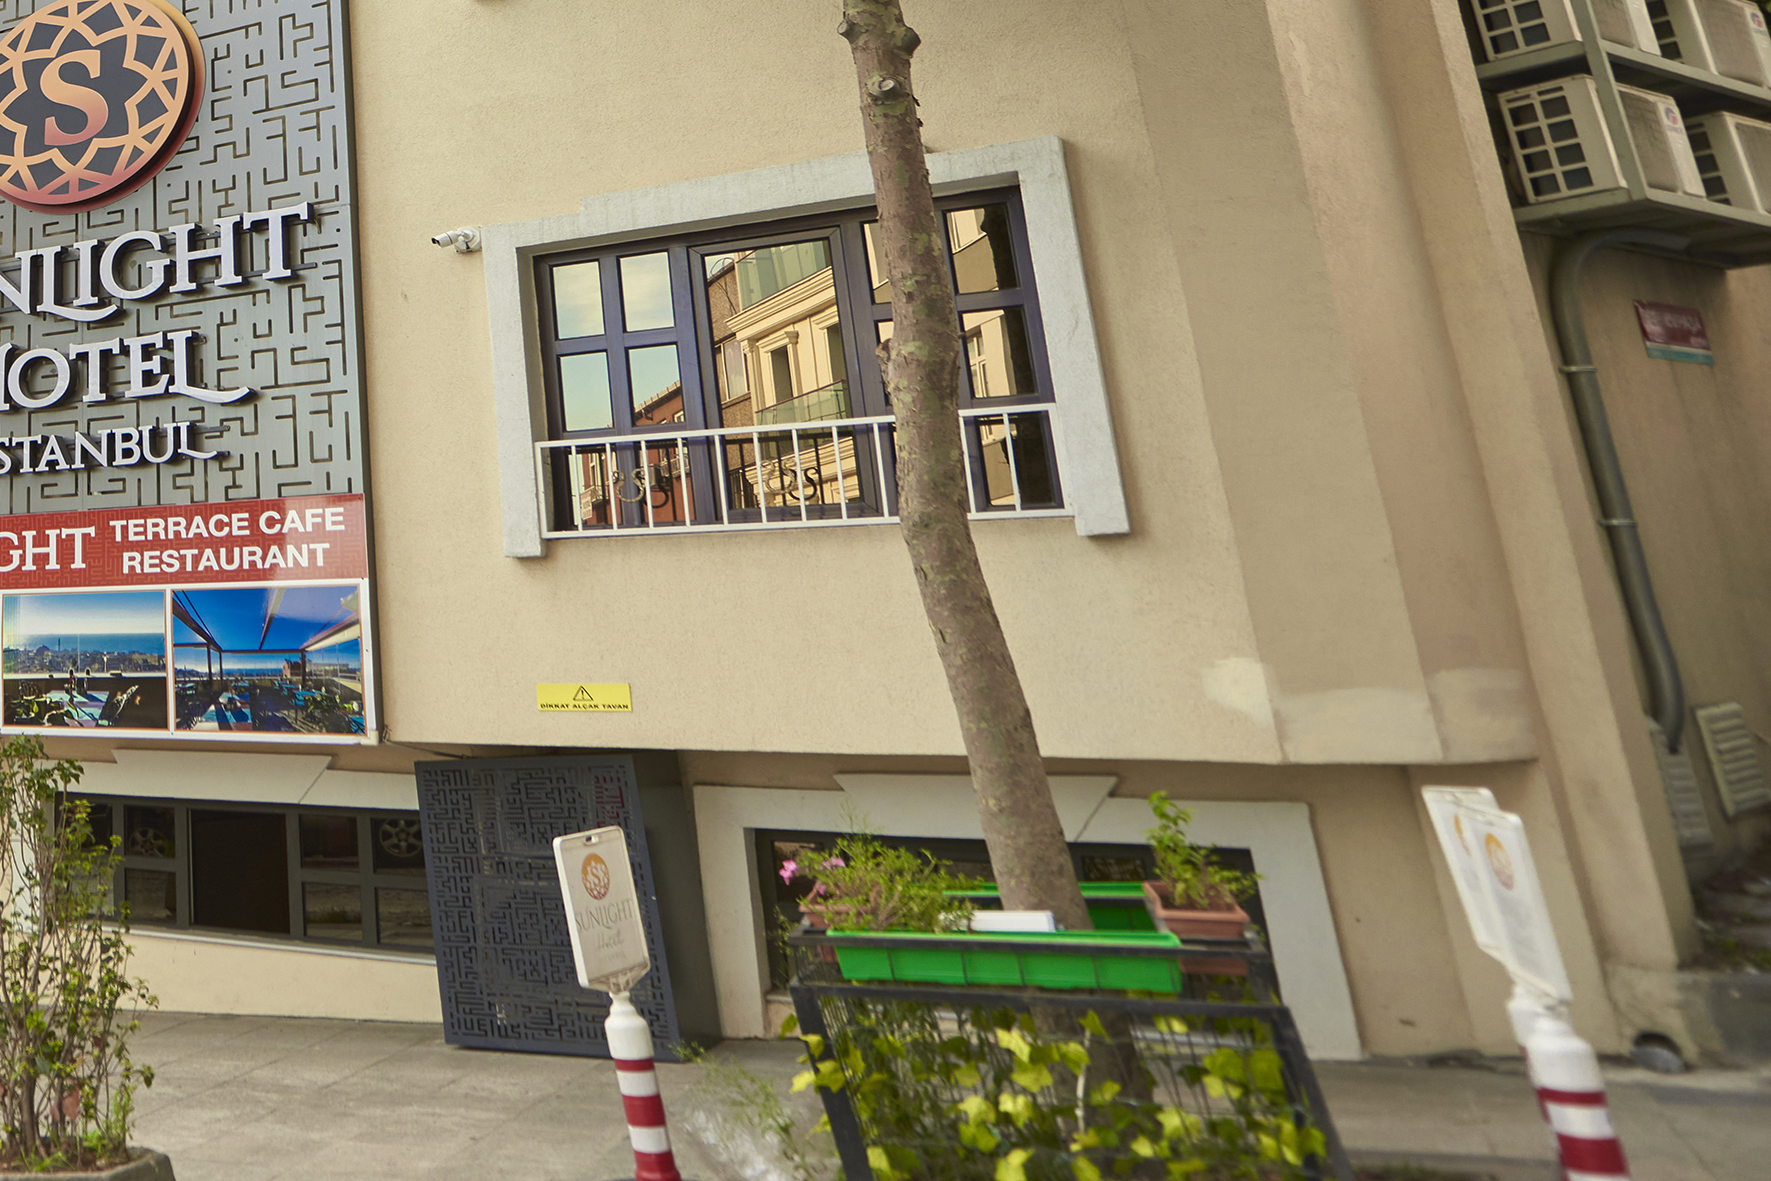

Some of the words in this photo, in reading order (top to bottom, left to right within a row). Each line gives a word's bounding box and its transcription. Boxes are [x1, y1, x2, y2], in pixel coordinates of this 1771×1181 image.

[39, 48, 109, 147] S
[109, 512, 251, 542] TERRACE
[258, 506, 346, 535] CAFE
[122, 543, 331, 575] RESTAURANT
[574, 898, 634, 933] SUNLIGHT
